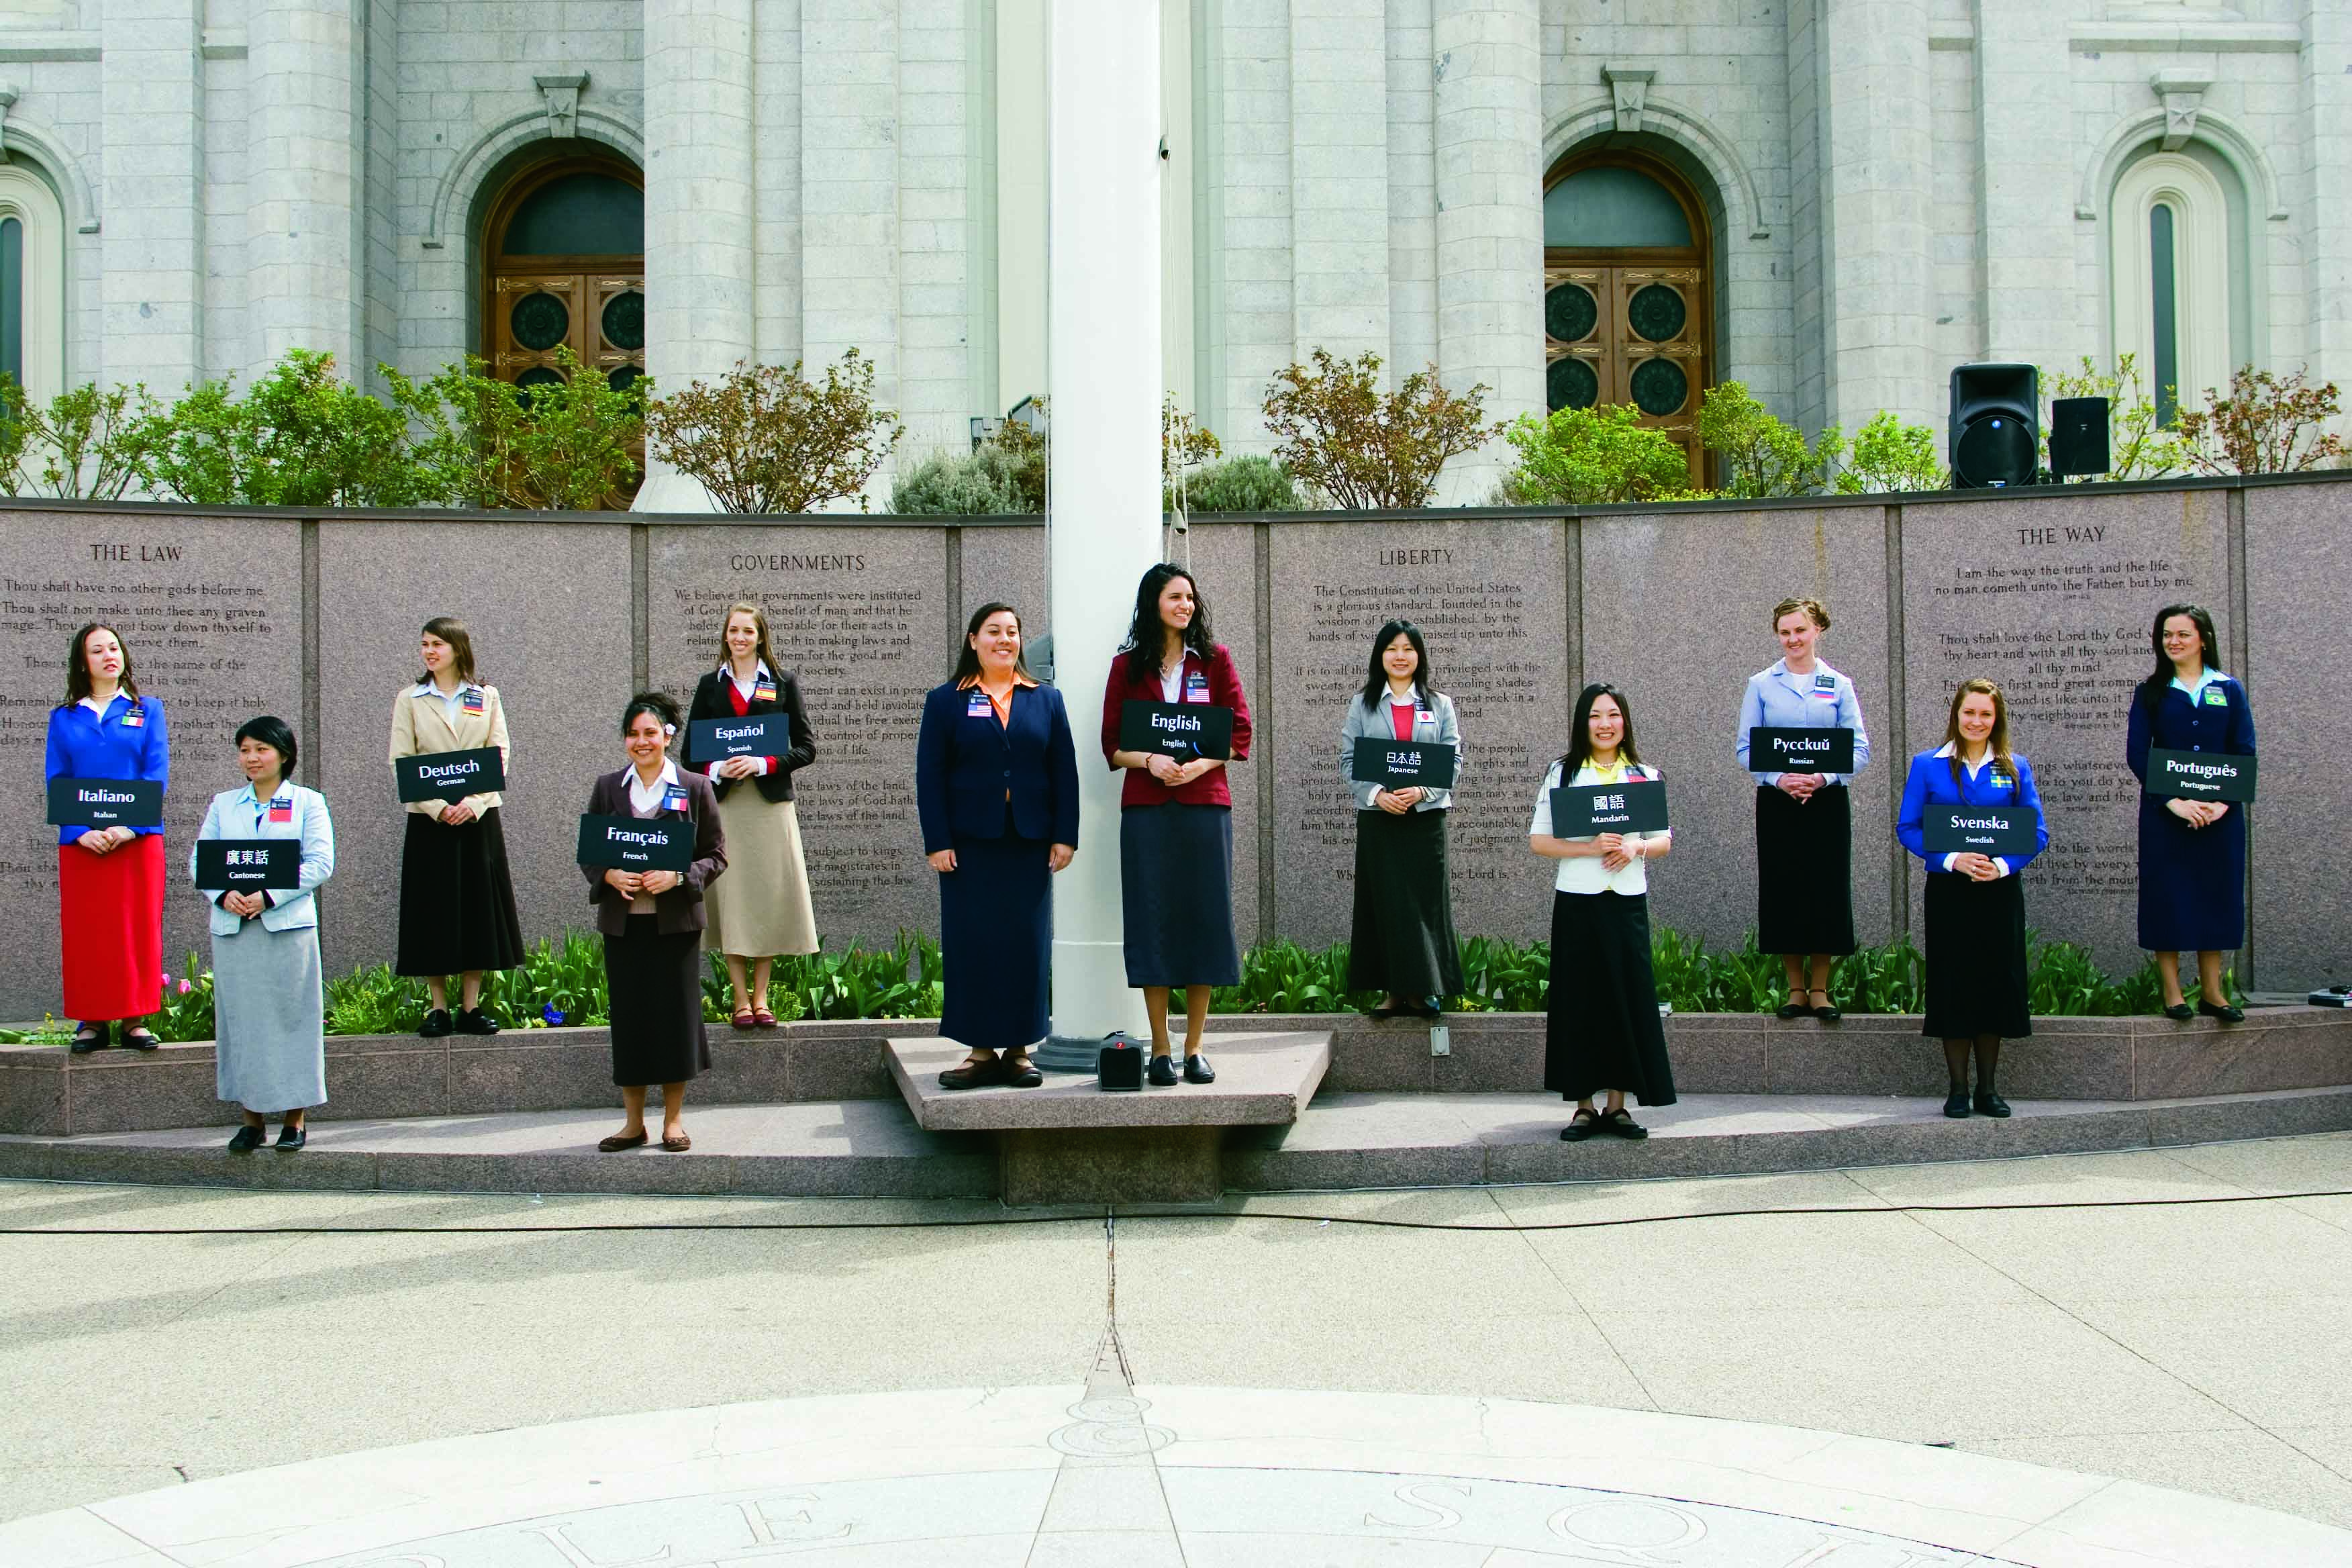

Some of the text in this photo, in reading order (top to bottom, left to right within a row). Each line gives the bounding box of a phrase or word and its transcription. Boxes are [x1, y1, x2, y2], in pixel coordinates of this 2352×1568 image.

[2017, 526, 2105, 544] THE WAY
[90, 544, 182, 562] THE LAW
[1379, 549, 1454, 565] LIBERTY
[731, 555, 865, 571] GOVERNMENTS
[1988, 561, 2145, 577] the the truth and the
[5, 579, 241, 598] Thou shalt have other gods before
[1314, 582, 1520, 597] The Constitution the United States
[1955, 577, 2149, 595] man cometh unto the but
[675, 589, 691, 600] We
[695, 590, 734, 601] believe
[739, 590, 758, 601] that
[763, 591, 833, 603] governments
[871, 590, 921, 601] instituted
[2, 601, 265, 620] Thou shalt make unto thee any graven
[768, 605, 895, 616] benefit and that
[1336, 597, 1522, 614] glorious founded the
[1317, 613, 1520, 626] wisdom the
[46, 619, 77, 631] Thou
[140, 622, 166, 632] bow
[174, 622, 207, 632] down
[213, 622, 254, 635] thyself
[777, 634, 910, 648] both making laws and
[1309, 627, 1528, 642] hands raised unto this
[1939, 628, 2141, 645] Thou shalt love the Lord thy God
[850, 650, 901, 663] good and
[1944, 646, 2073, 663] thy heart and with all
[1435, 662, 1542, 676] privileged with the
[2028, 663, 2065, 676] all thy
[1306, 677, 1533, 691] sweets cooling shades
[2008, 678, 2095, 692] first and great
[861, 687, 885, 695] exist
[196, 697, 226, 709] keep
[832, 700, 878, 710] and held
[1455, 693, 1510, 705] great rock
[2056, 693, 2109, 704] like unto
[845, 715, 887, 726] the free
[1151, 713, 1201, 732] English
[2030, 709, 2091, 724] neighbour
[716, 724, 764, 741] Español
[824, 730, 863, 740] control
[728, 744, 752, 753] Spanish
[1162, 738, 1187, 748] English
[1309, 744, 1484, 756] The the
[1386, 751, 1422, 766] 日本語
[1475, 757, 1528, 772] rights and
[419, 758, 480, 779] Deutsch
[1387, 765, 1418, 774] Japanese
[2166, 760, 2237, 779] Português
[437, 778, 466, 787] German
[1520, 773, 1540, 783] and
[796, 780, 879, 791] the laws the
[2180, 781, 2220, 791] Portuguese
[79, 789, 136, 803] Italiano
[798, 794, 914, 805] the laws God hath
[2063, 791, 2134, 802] law and the
[1594, 794, 1625, 812] 國語
[818, 810, 879, 821] laws the
[1591, 814, 1630, 824] Mandarin
[1457, 818, 1522, 828] accountable
[1951, 815, 2009, 830] Svenska
[607, 826, 669, 846] Français
[1322, 833, 1521, 846] his judgment
[1965, 836, 1995, 844] Swedish
[813, 846, 854, 859] subject
[2073, 842, 2134, 853] the words
[226, 849, 269, 865] 廣東話
[622, 851, 648, 861] French
[825, 863, 887, 873] magistrates
[2047, 859, 2129, 872] live every
[229, 871, 266, 879] Cantonese
[1468, 869, 1494, 879] Lord
[815, 875, 890, 889] sustaining the
